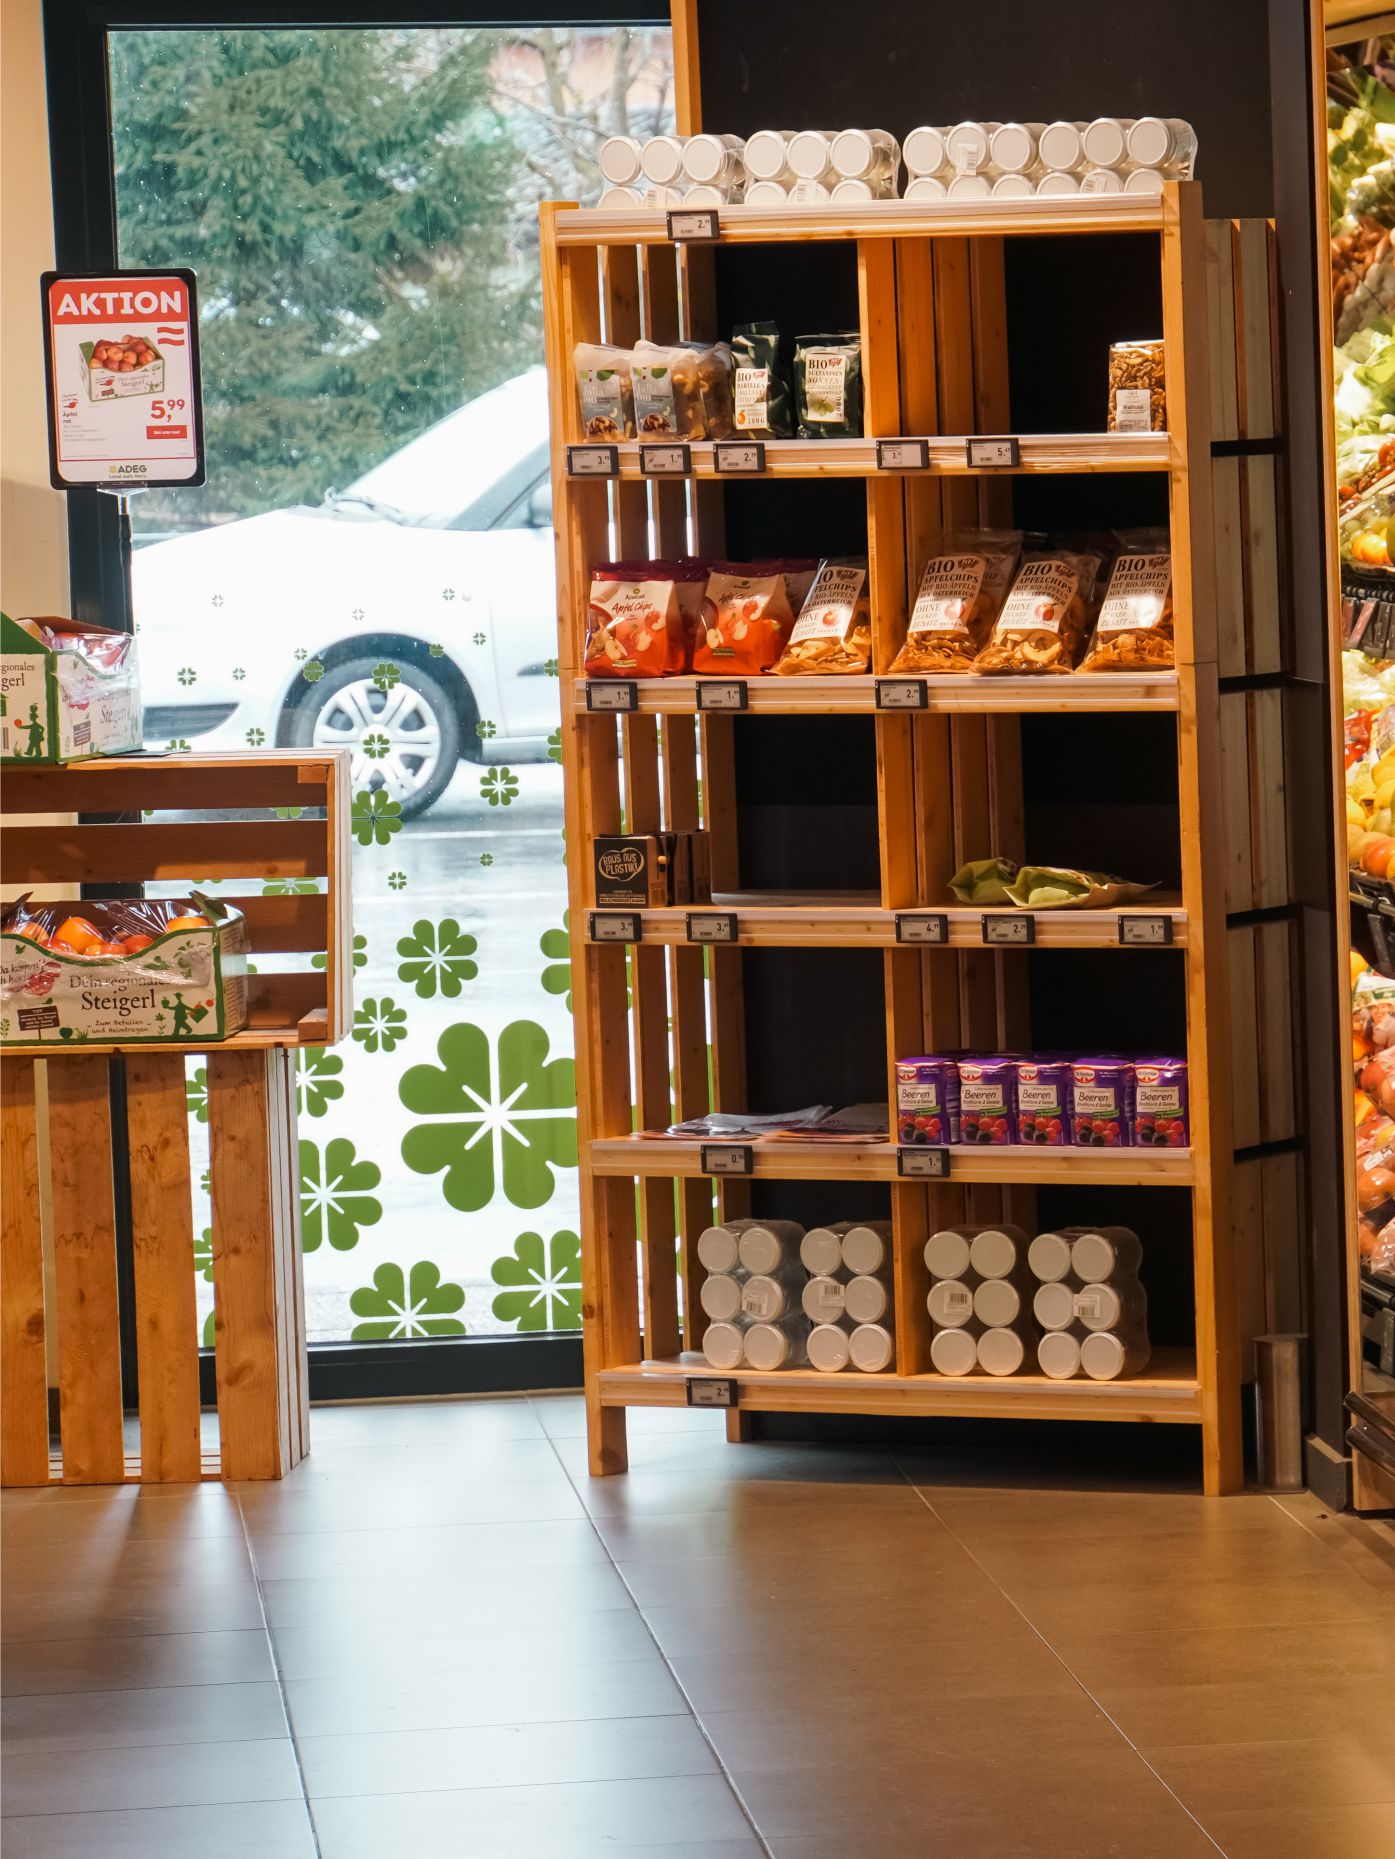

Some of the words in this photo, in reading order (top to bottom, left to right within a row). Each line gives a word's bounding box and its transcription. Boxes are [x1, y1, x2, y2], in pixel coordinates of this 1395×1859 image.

[57, 290, 182, 316] AKTION
[808, 359, 828, 369] BIO
[737, 372, 752, 382] BIO
[150, 399, 185, 422] 5,99
[117, 465, 147, 473] ADEG
[926, 559, 955, 575] BIO
[1023, 563, 1052, 576] BIO
[1116, 558, 1146, 573] BIO
[924, 573, 979, 584] APFELCHIPS
[1114, 572, 1169, 581] APFELCHIPS
[814, 582, 857, 593] FELCHIPS
[1019, 576, 1073, 594] APFELCHIPS
[611, 602, 634, 615] Apfel
[634, 600, 654, 614] Chips
[915, 602, 942, 614] OHNE
[1006, 602, 1033, 611] OHNE
[1104, 601, 1130, 611] OHNE
[0, 661, 35, 675] gionales
[602, 853, 622, 866] RAUS
[622, 853, 637, 863] AUS
[605, 861, 639, 875] PLASTIK!
[68, 974, 101, 989] Dein
[81, 989, 156, 1017] Steigerl
[901, 1088, 930, 1099] Beeren
[964, 1089, 997, 1100] Beeren
[1022, 1088, 1051, 1100] Beeren
[1078, 1091, 1109, 1103] Beeren
[1140, 1091, 1173, 1101] Beeren
